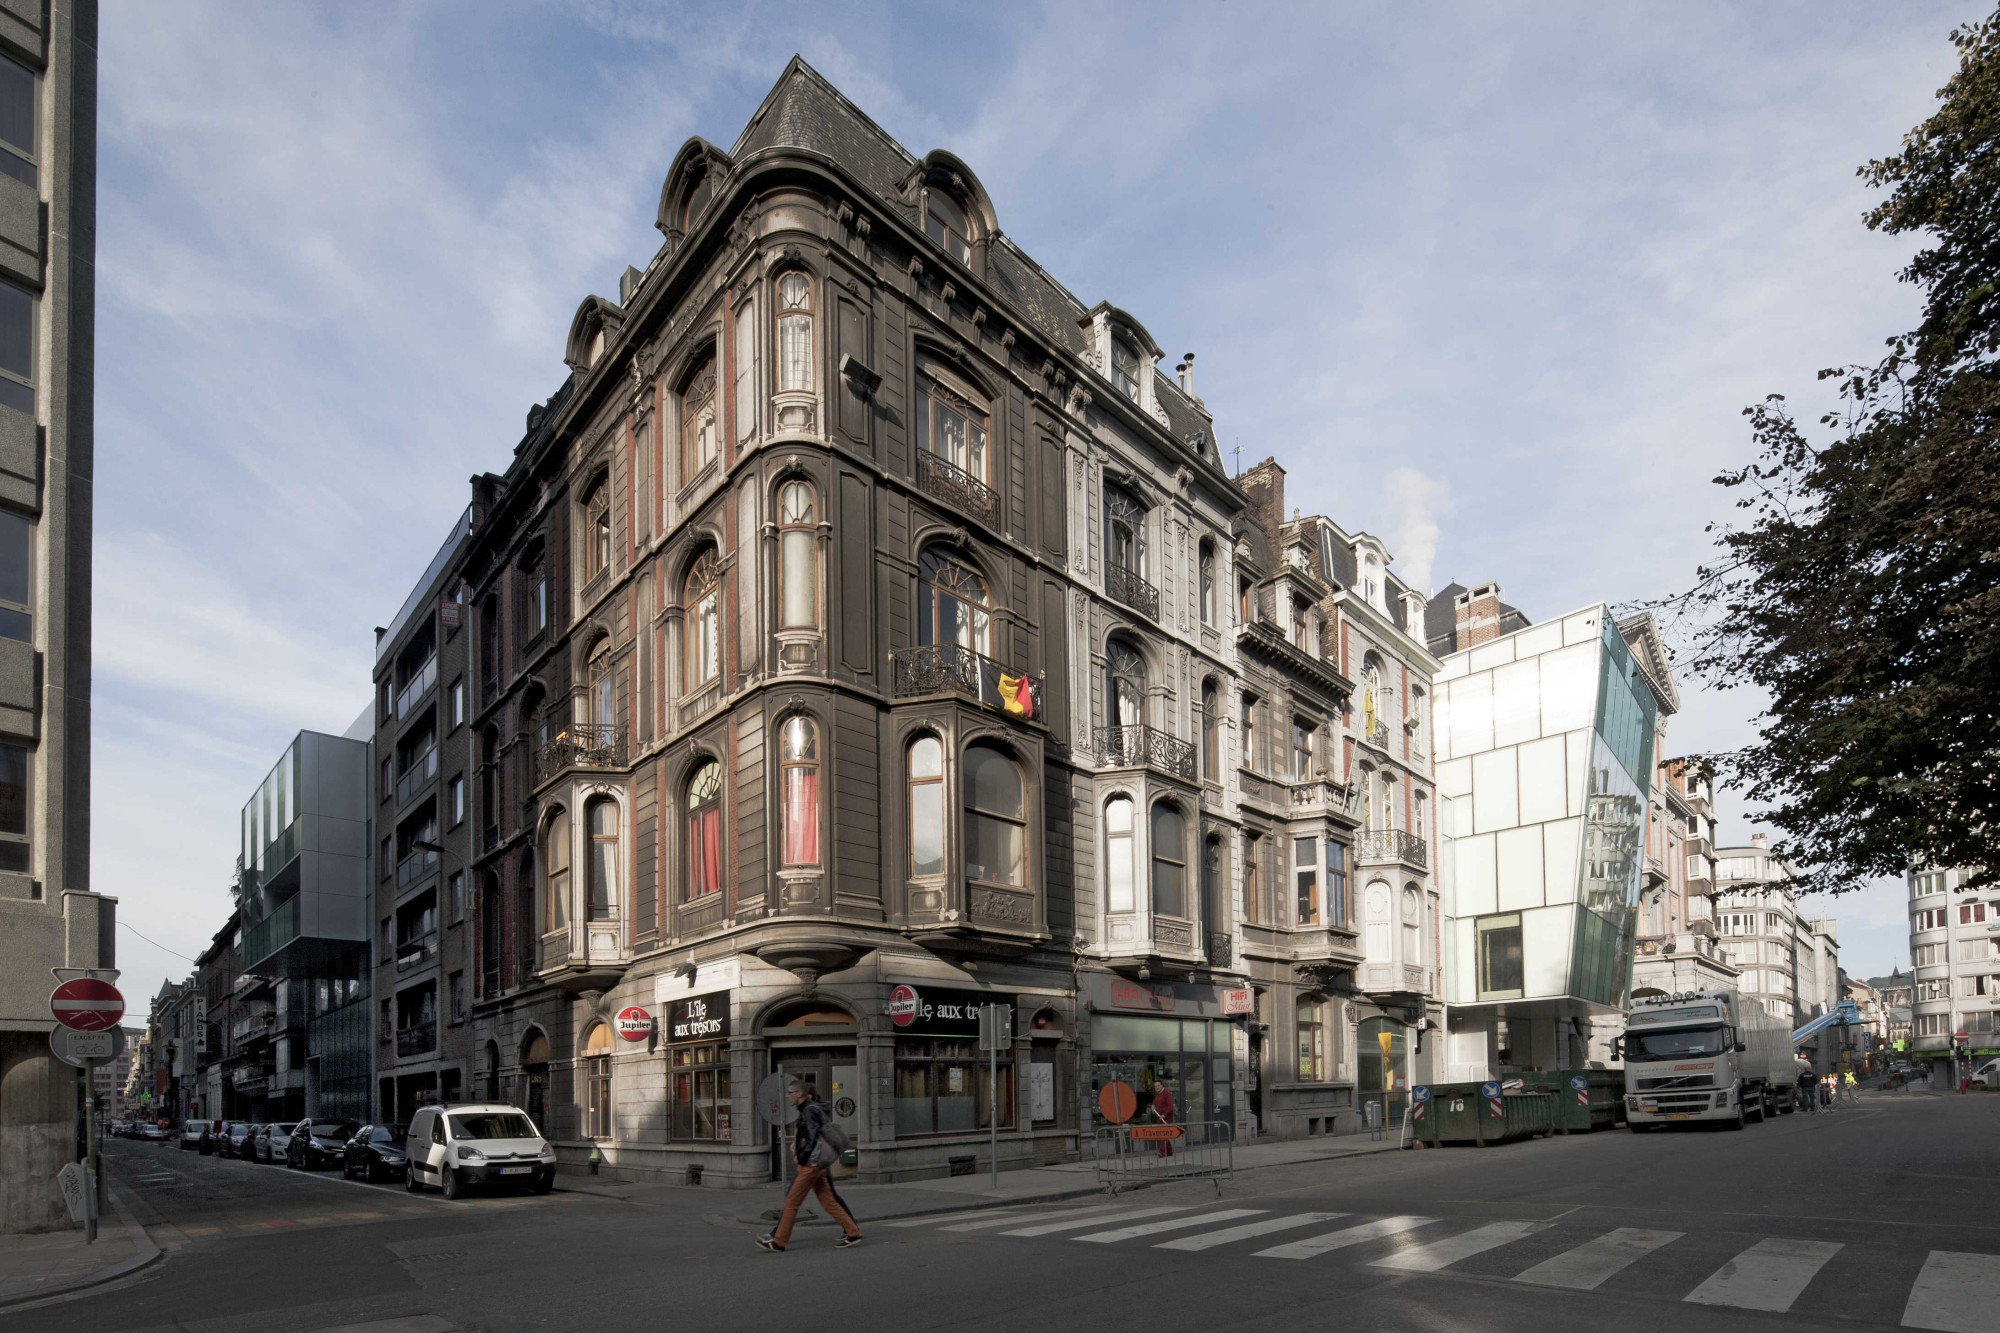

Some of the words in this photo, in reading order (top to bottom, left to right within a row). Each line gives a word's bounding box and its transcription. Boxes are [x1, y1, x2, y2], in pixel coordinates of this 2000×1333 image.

[1115, 985, 1138, 1002] HiFi
[1230, 991, 1248, 1001] HiFi
[890, 1002, 914, 1013] Jupiler
[936, 1004, 962, 1020] aux
[196, 998, 204, 1038] PIANOS
[620, 1021, 651, 1031] Jupiler
[674, 1024, 690, 1036] aux
